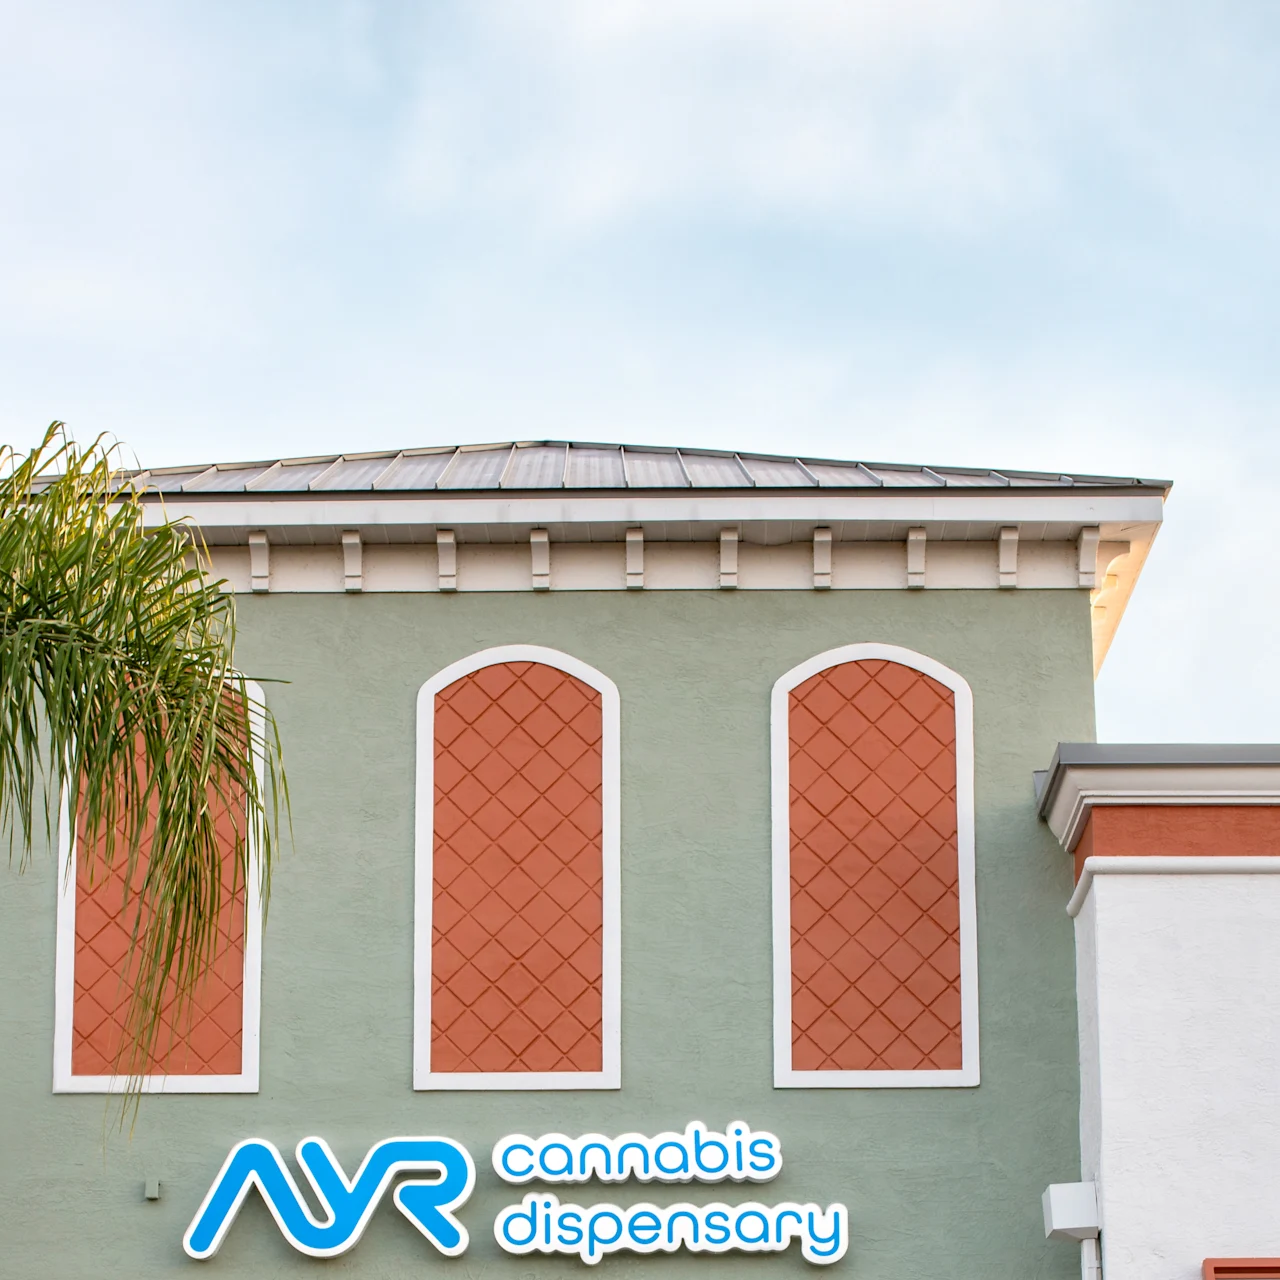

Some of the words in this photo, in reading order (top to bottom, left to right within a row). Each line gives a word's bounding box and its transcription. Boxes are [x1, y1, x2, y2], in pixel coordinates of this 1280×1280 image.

[499, 1124, 778, 1179] cannabis
[187, 1141, 471, 1256] AYR
[499, 1197, 842, 1259] dispensary
